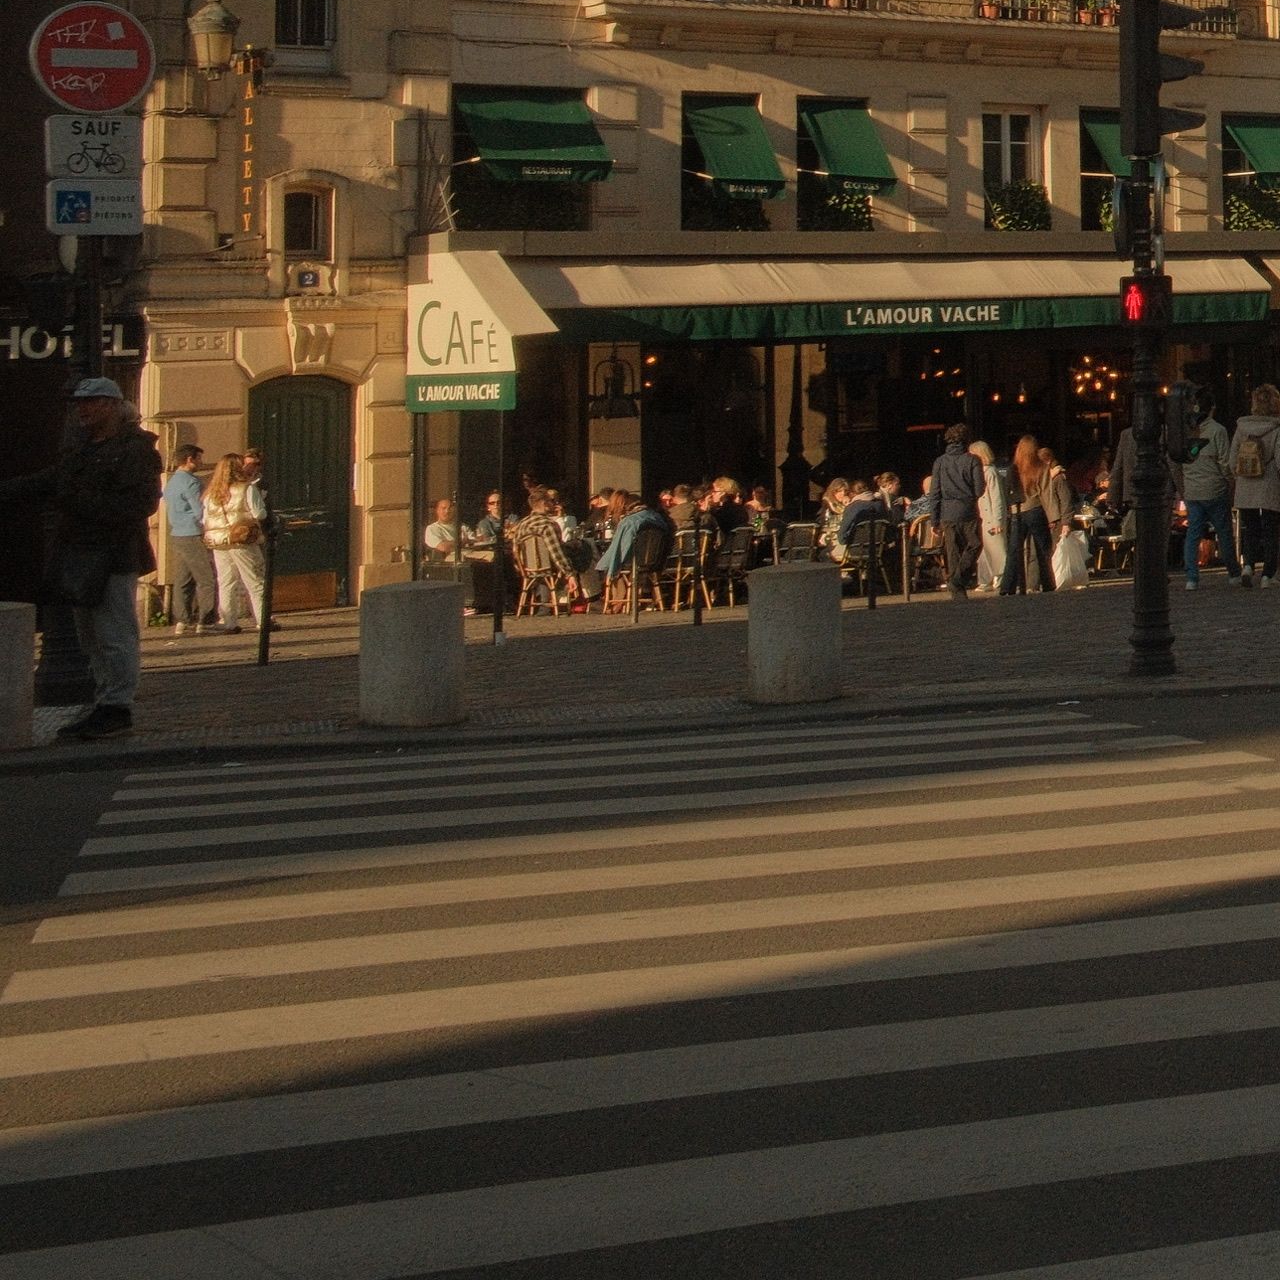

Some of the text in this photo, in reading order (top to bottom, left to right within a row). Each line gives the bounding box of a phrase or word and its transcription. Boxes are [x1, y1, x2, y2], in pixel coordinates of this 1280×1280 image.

[71, 121, 121, 135] SAUF
[522, 166, 572, 175] RESTAURANT
[304, 274, 314, 285] 2
[846, 305, 1000, 326] L'AMOUR VACHE
[417, 300, 500, 366] CAFÉ
[418, 384, 500, 402] L'AMOUR VACHE
